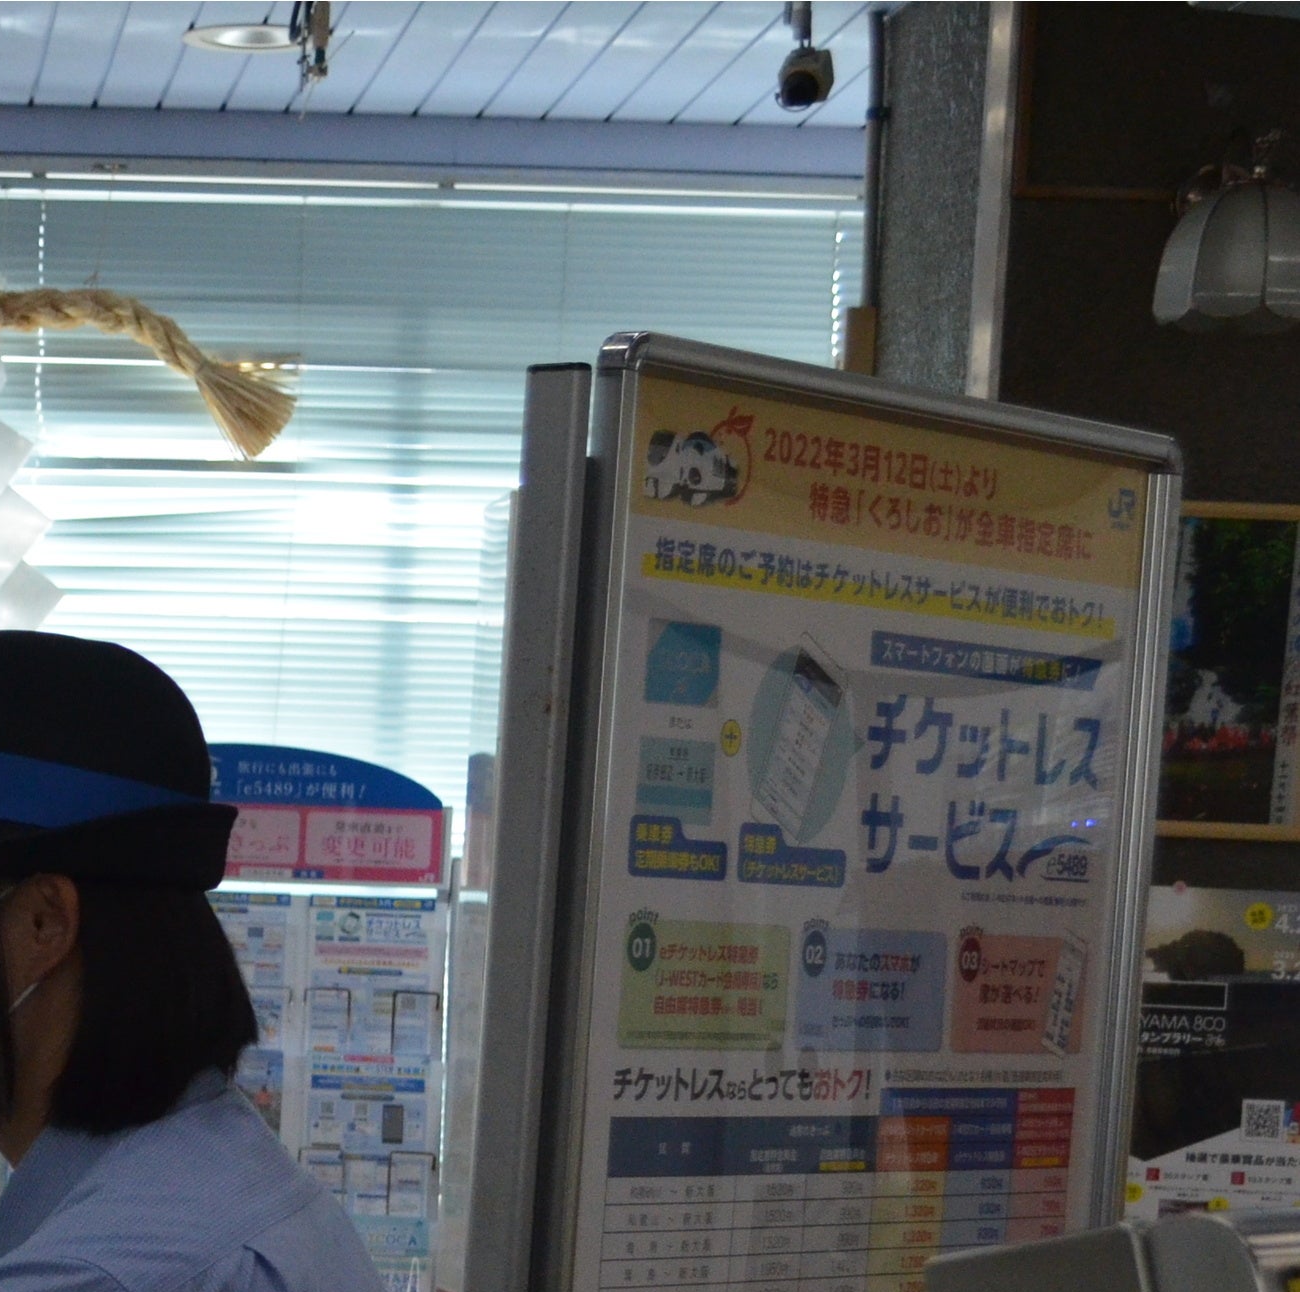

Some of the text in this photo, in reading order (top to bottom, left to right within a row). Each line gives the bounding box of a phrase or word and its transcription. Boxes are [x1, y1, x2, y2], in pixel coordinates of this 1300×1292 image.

[809, 482, 1093, 562] 特急「くろしお」が全車指定席に
[868, 694, 1101, 790] チケットレス
[321, 835, 416, 861] 変更可能
[861, 792, 1019, 882] サービス
[631, 937, 652, 958] 01
[805, 945, 825, 965] 02
[961, 952, 979, 972] 03
[612, 1067, 872, 1103] チケットレスならとってもおトク!
